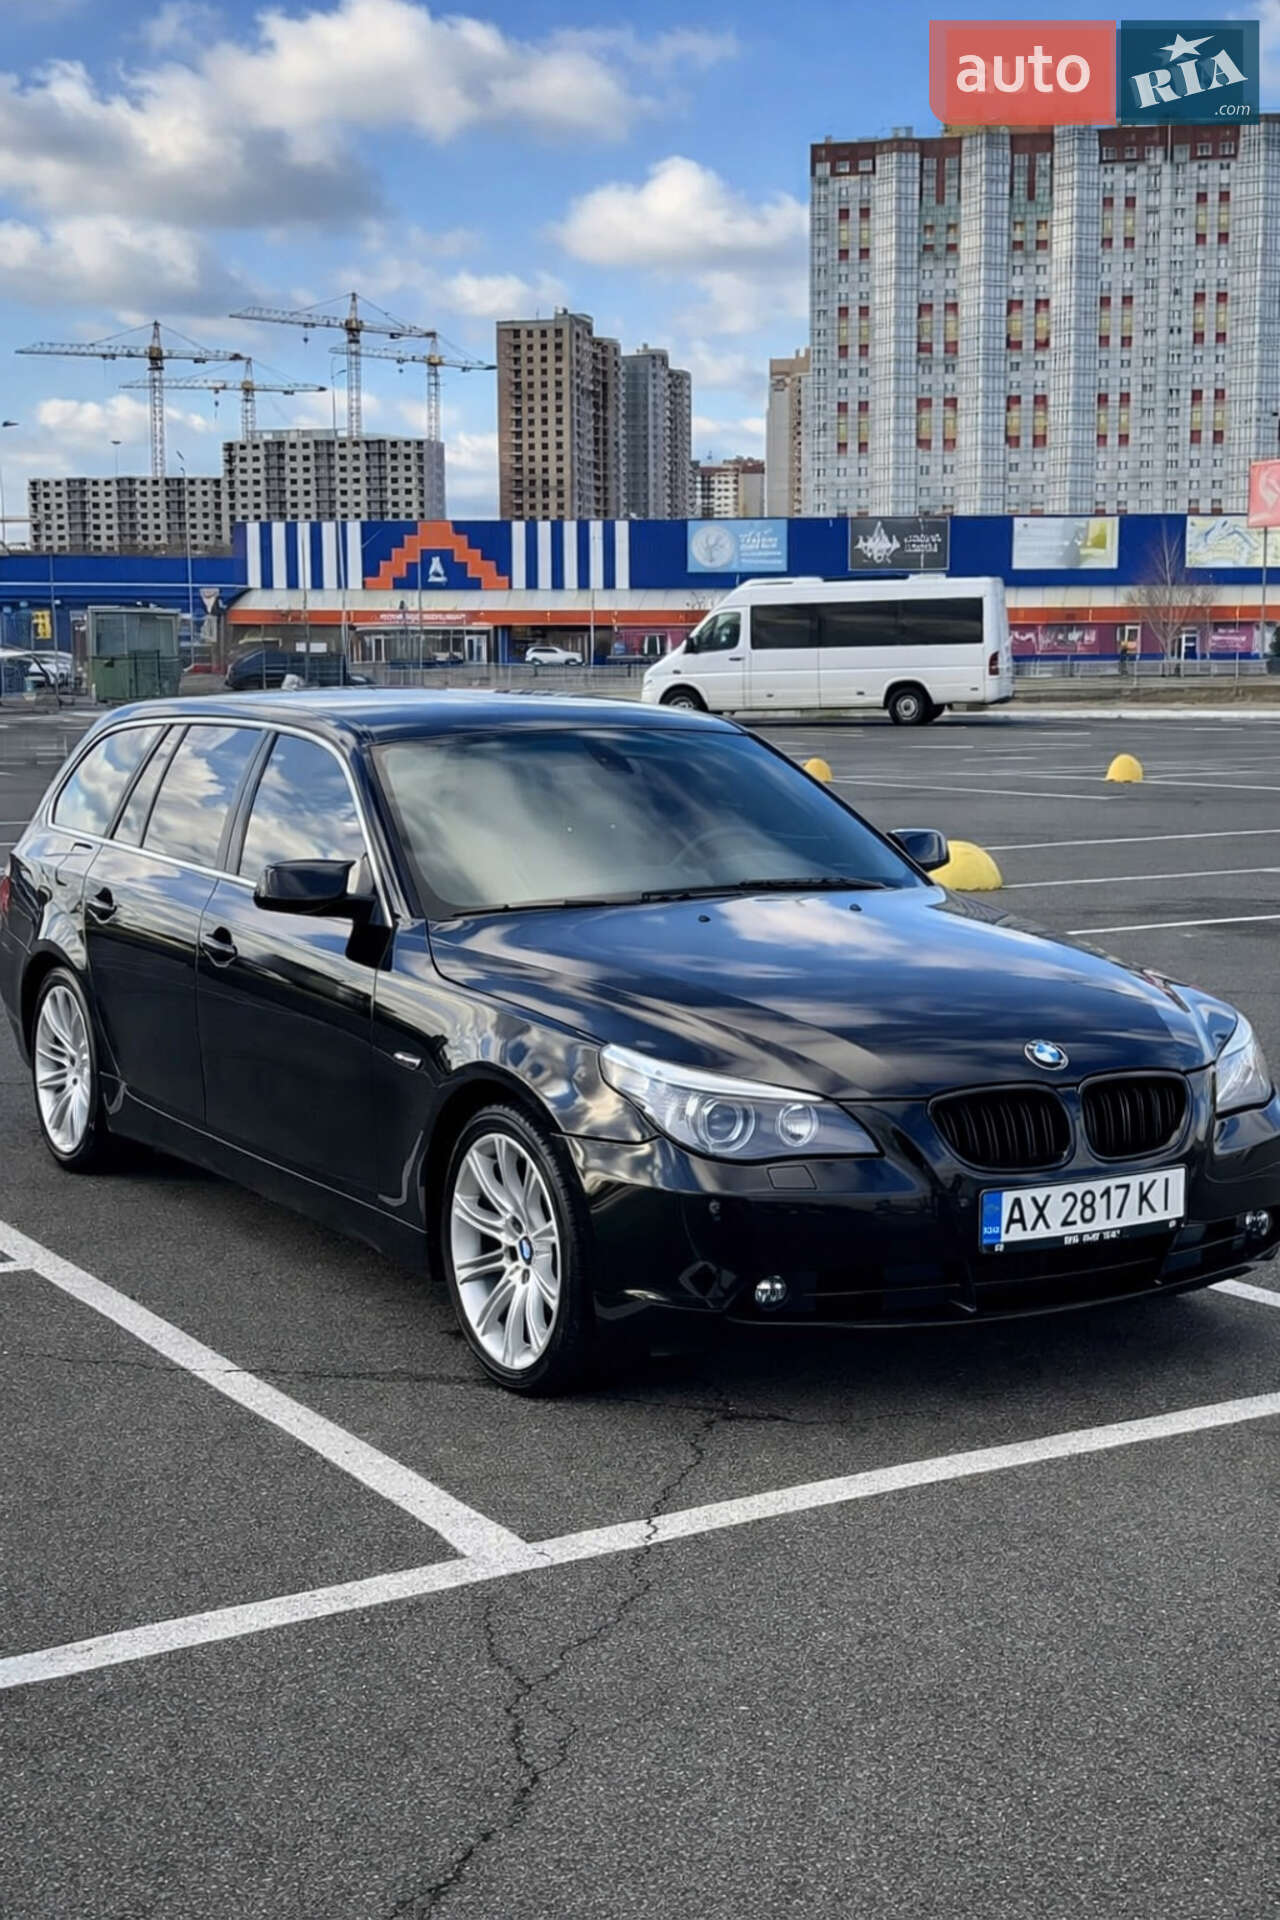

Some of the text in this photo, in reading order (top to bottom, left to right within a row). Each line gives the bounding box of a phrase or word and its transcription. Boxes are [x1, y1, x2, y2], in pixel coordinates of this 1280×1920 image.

[1005, 1177, 1169, 1234] AX 2817 KI
